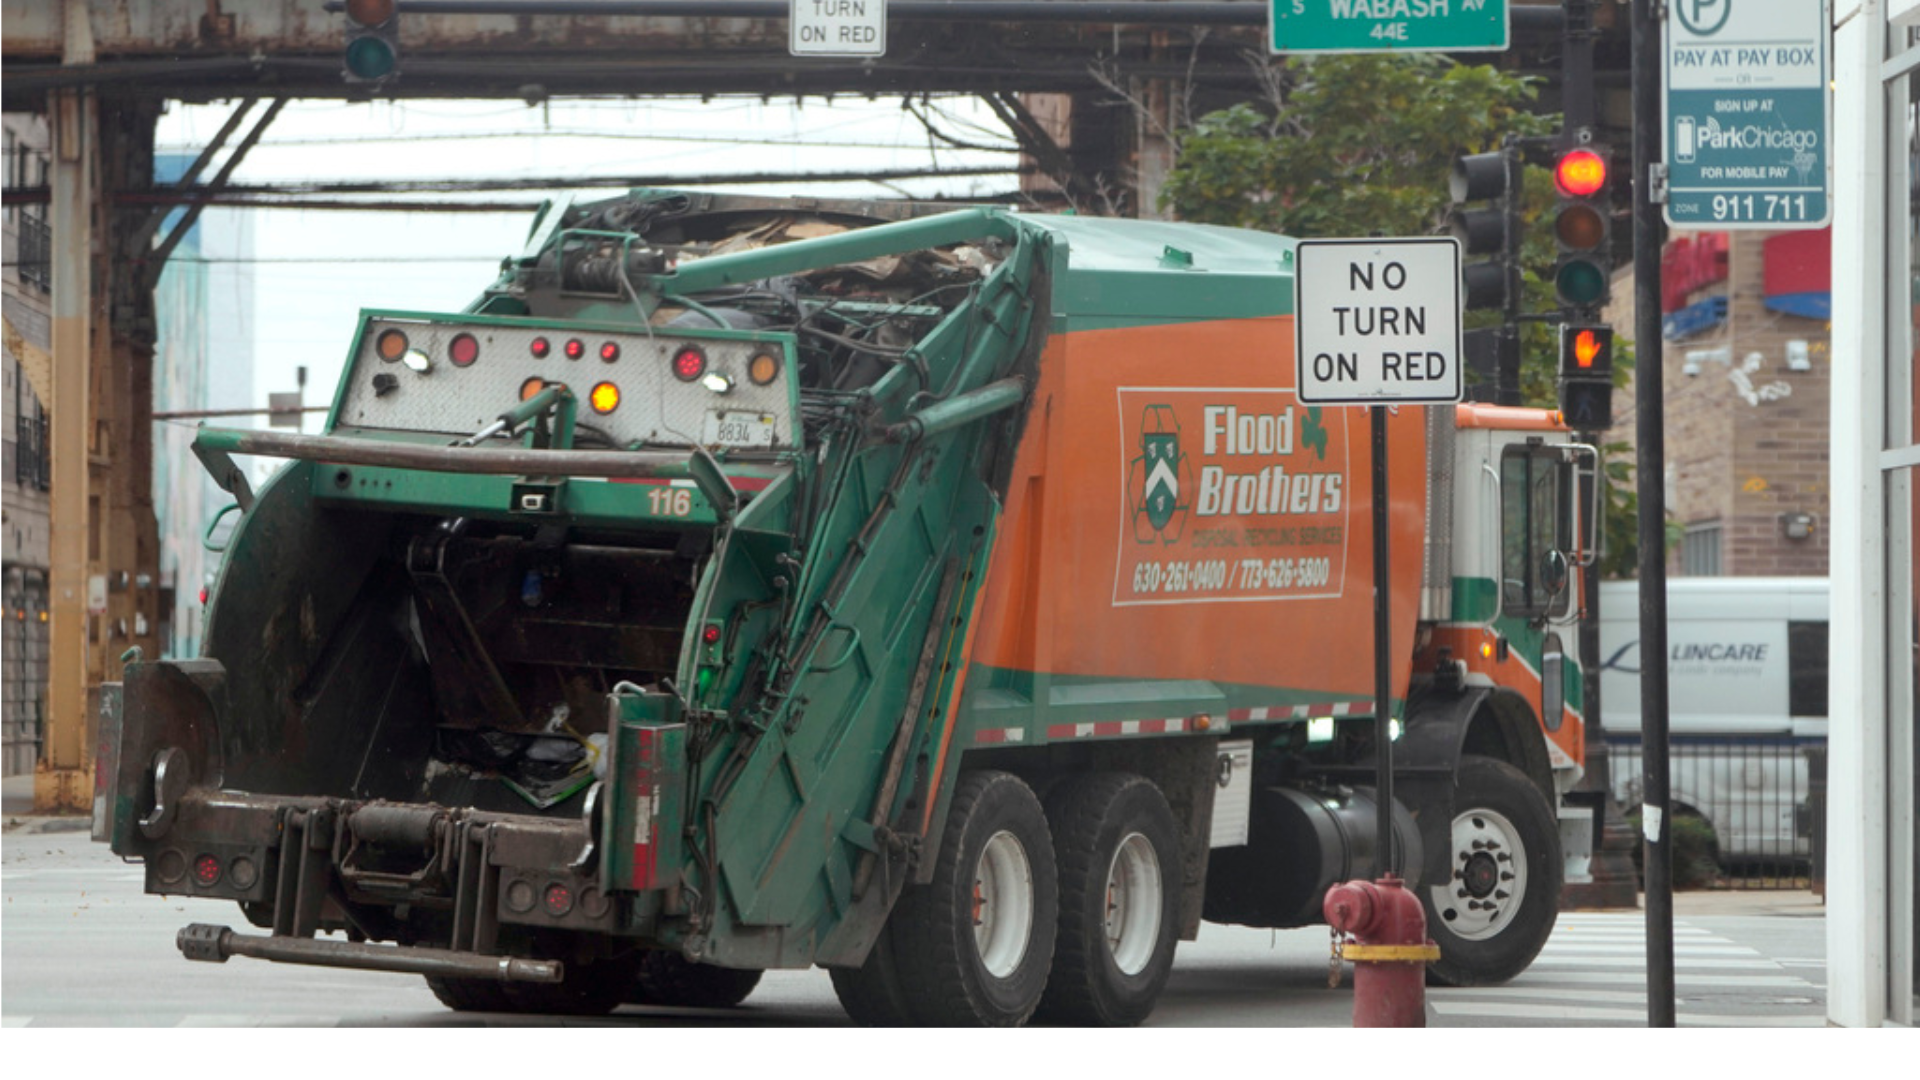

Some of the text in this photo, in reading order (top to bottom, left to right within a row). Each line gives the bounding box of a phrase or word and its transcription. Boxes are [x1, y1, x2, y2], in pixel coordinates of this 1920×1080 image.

[812, 0, 866, 17] TURN
[1292, 0, 1486, 19] S WABASH AV
[801, 25, 876, 42] ON RED
[1369, 22, 1409, 40] 44E
[1674, 48, 1814, 66] PAY AT PAY BOX
[1736, 74, 1752, 84] OR
[1714, 100, 1774, 112] SIGN UP AT
[1697, 124, 1818, 153] ParkChicago
[1701, 166, 1789, 179] FOR MOBILE PAY
[1675, 194, 1806, 220] ZONE 911 711
[1350, 262, 1406, 290] NO
[1332, 306, 1425, 336] TURN
[1313, 351, 1446, 382] ON RED
[717, 422, 750, 442] 8834
[1203, 405, 1294, 455] Flood
[1196, 464, 1342, 515] Brothers
[648, 487, 691, 516] 116
[1671, 643, 1770, 661] LINCARE
